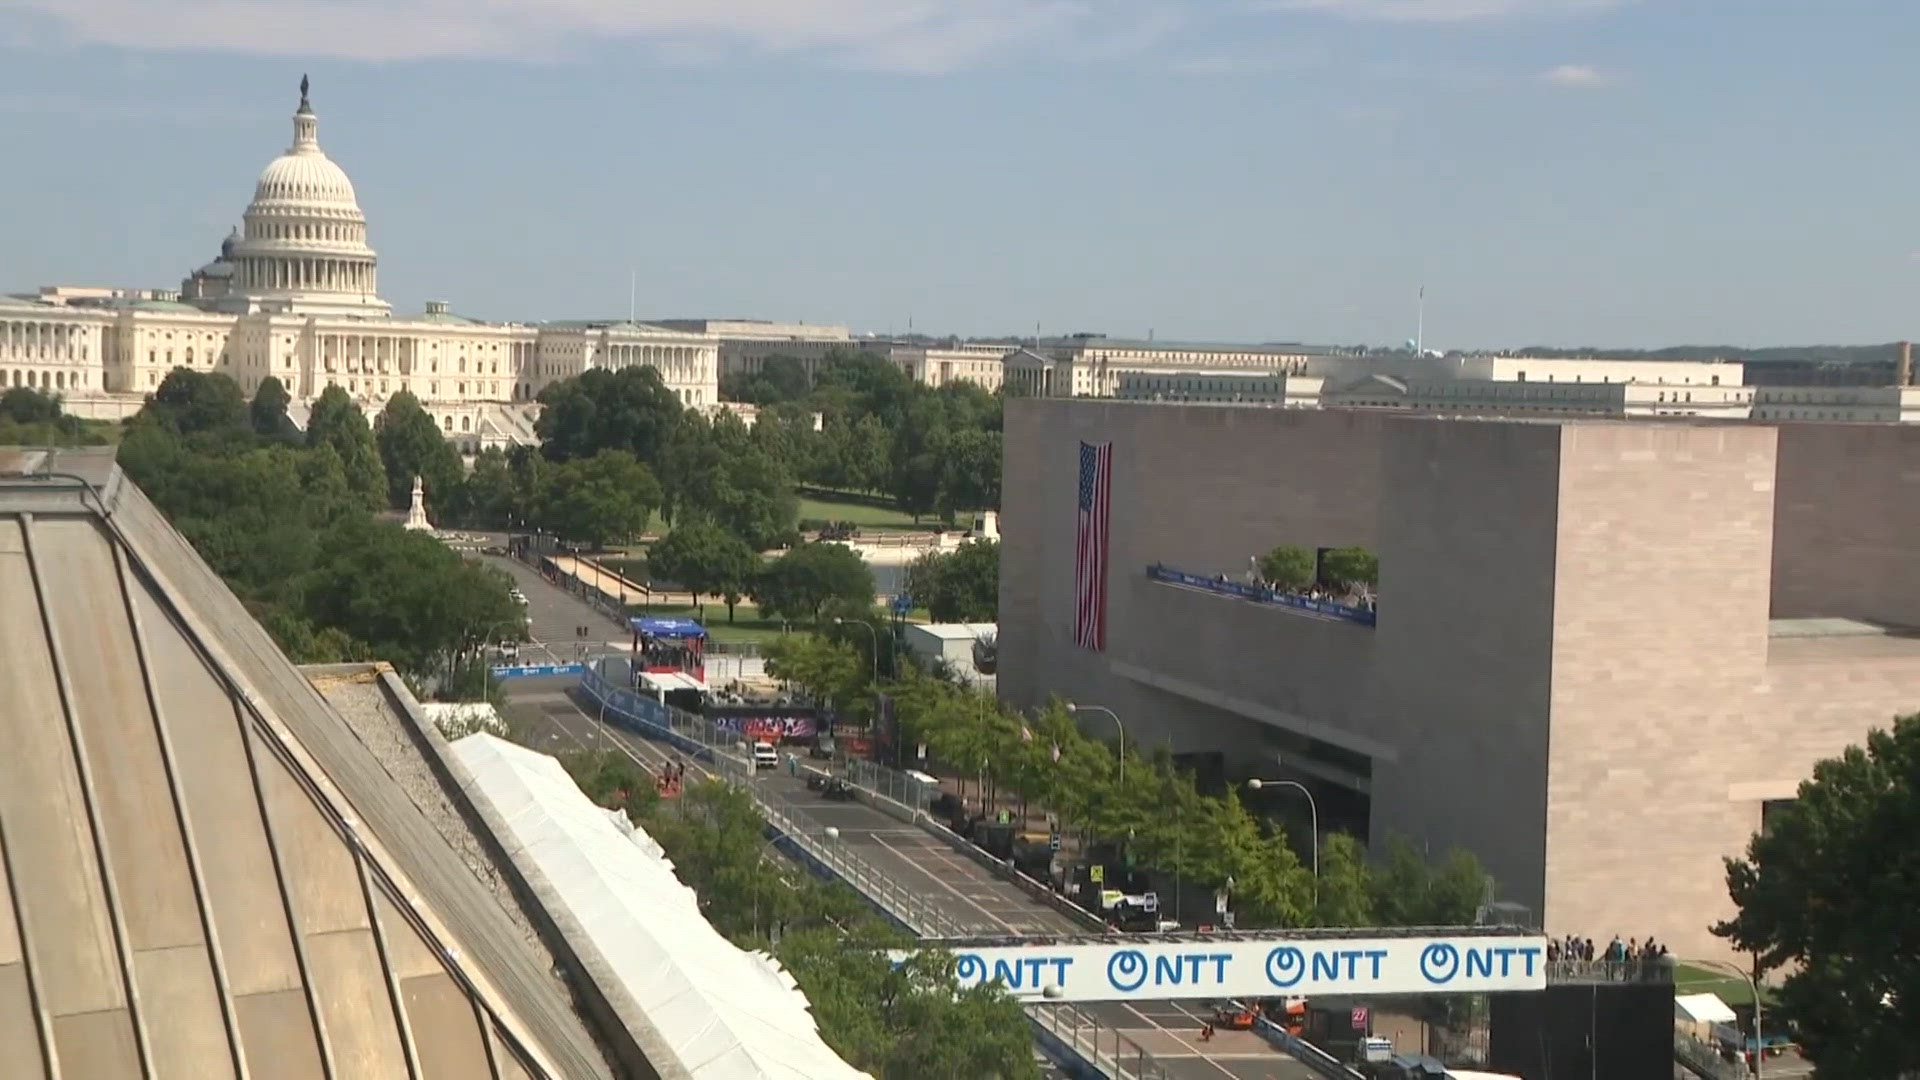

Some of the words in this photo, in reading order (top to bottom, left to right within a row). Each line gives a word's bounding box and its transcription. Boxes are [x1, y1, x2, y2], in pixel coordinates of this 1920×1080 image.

[994, 957, 1074, 989] NTT
[1155, 953, 1232, 984] NTT
[1312, 950, 1387, 981] NTT
[1466, 947, 1540, 977] NTT
